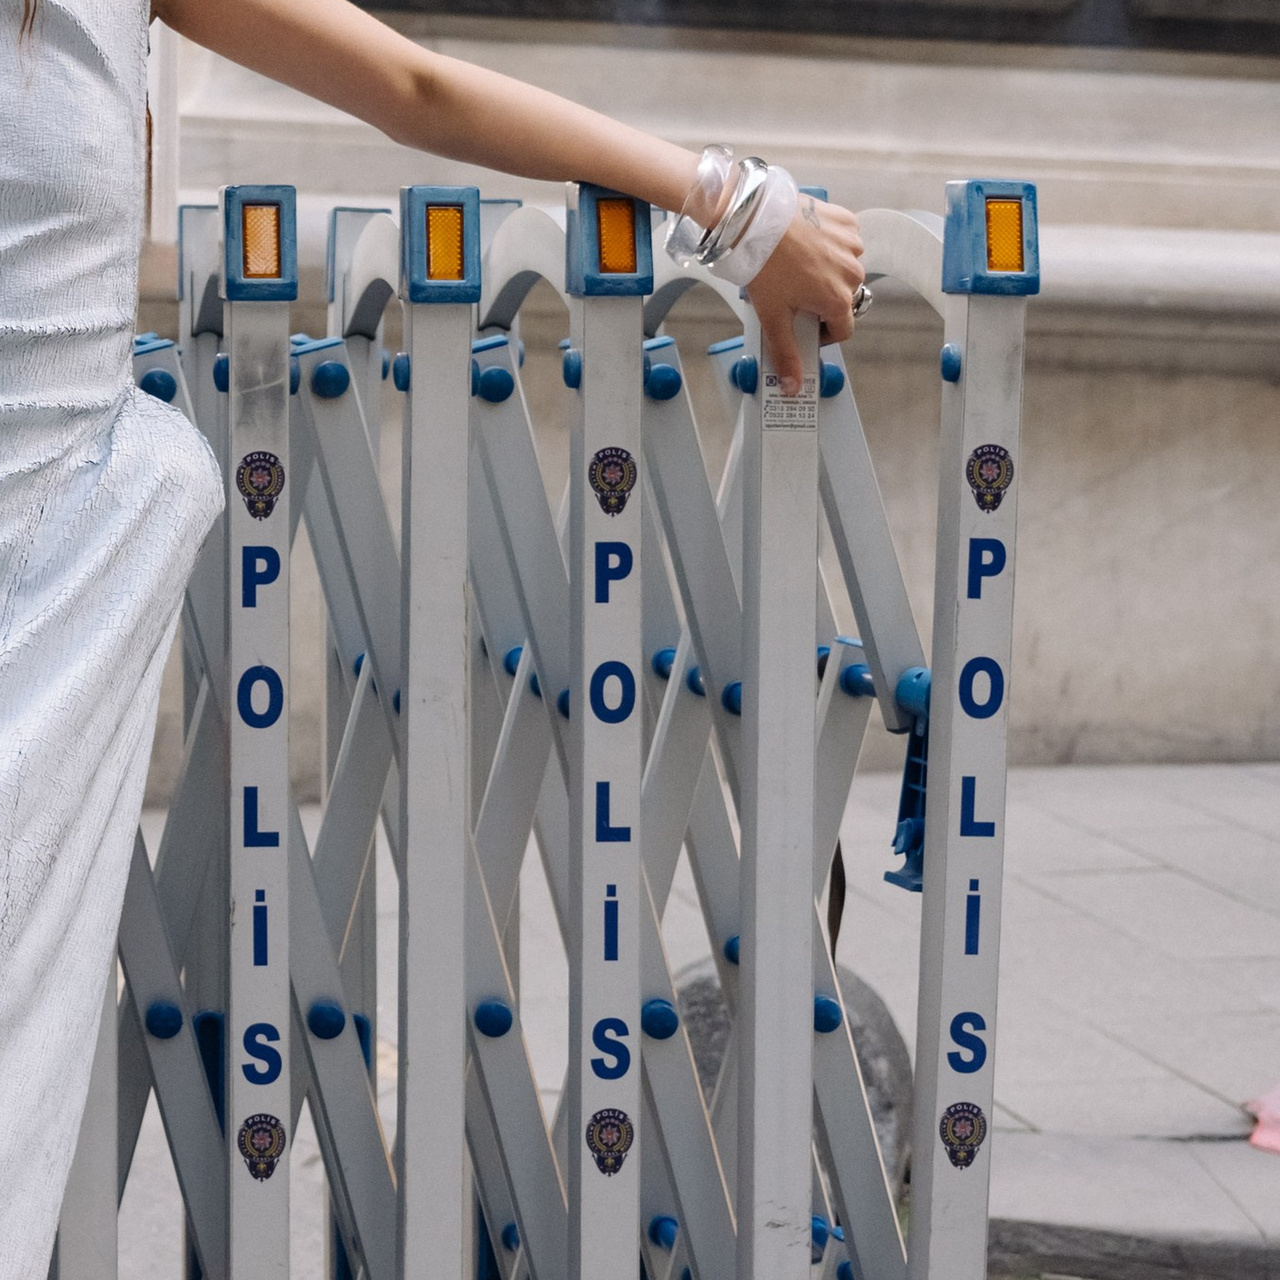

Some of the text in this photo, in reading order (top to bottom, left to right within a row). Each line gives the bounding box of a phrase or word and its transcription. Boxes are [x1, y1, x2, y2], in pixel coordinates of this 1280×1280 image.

[238, 547, 282, 1084] POLİS
[591, 543, 634, 1078] POLİS
[948, 539, 1005, 1073] POLİS
